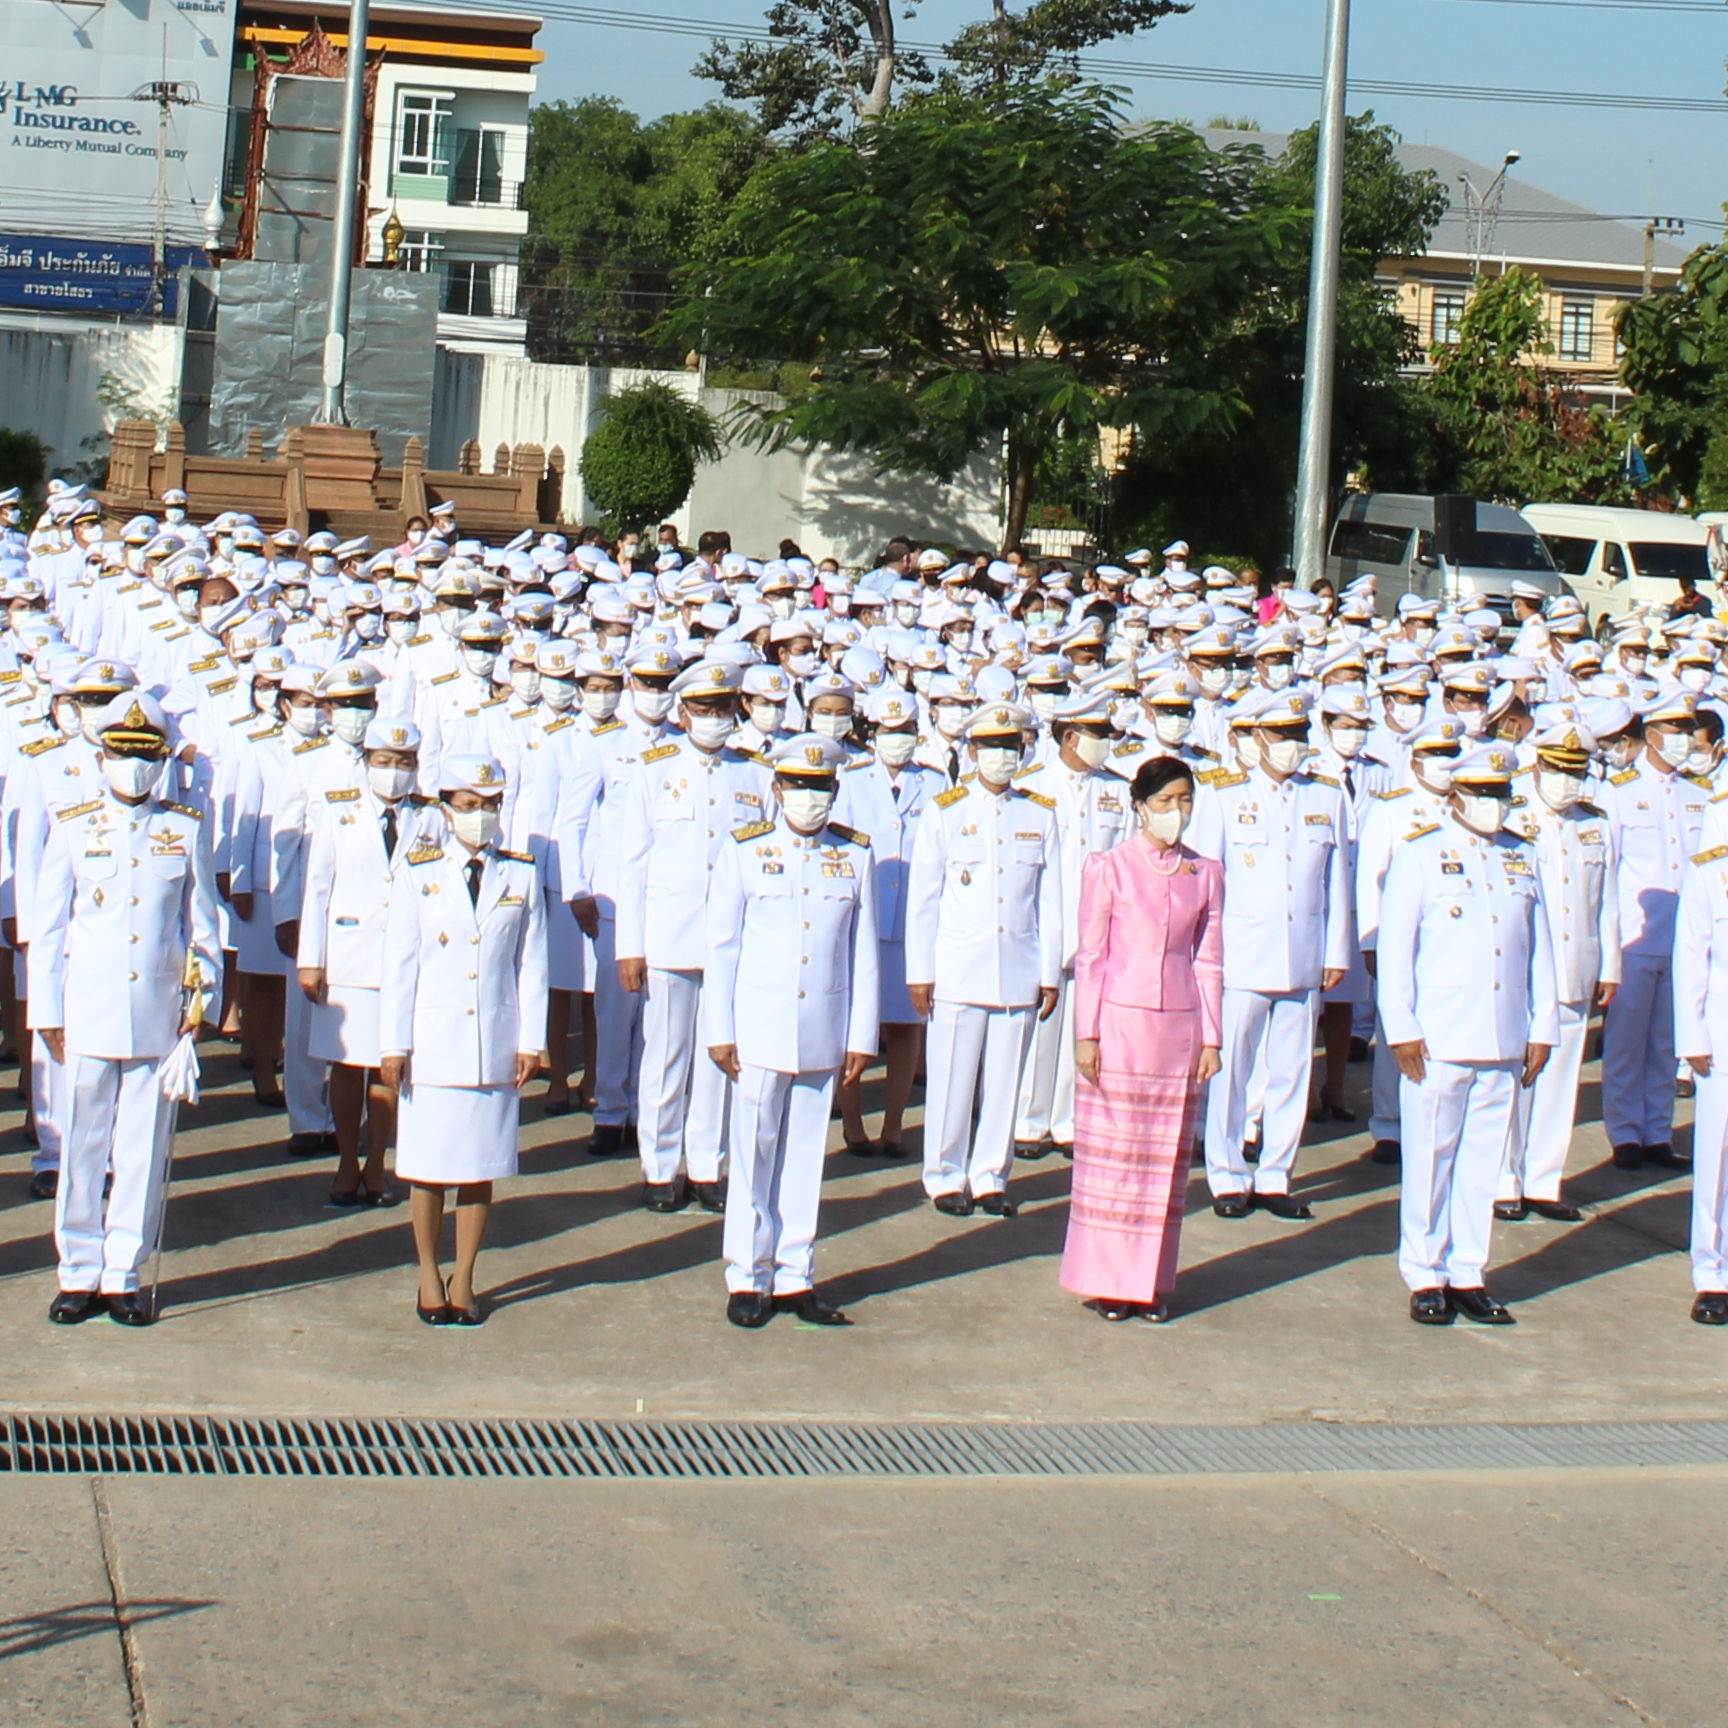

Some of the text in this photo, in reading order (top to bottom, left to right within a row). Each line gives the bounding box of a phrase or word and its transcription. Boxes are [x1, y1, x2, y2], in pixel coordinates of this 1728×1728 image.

[15, 81, 78, 108] LMG
[14, 106, 142, 135] Insurance.
[12, 135, 21, 147] A
[25, 136, 72, 153] Liberty
[75, 139, 122, 154] Mutual
[39, 251, 121, 275] ประกันภัย
